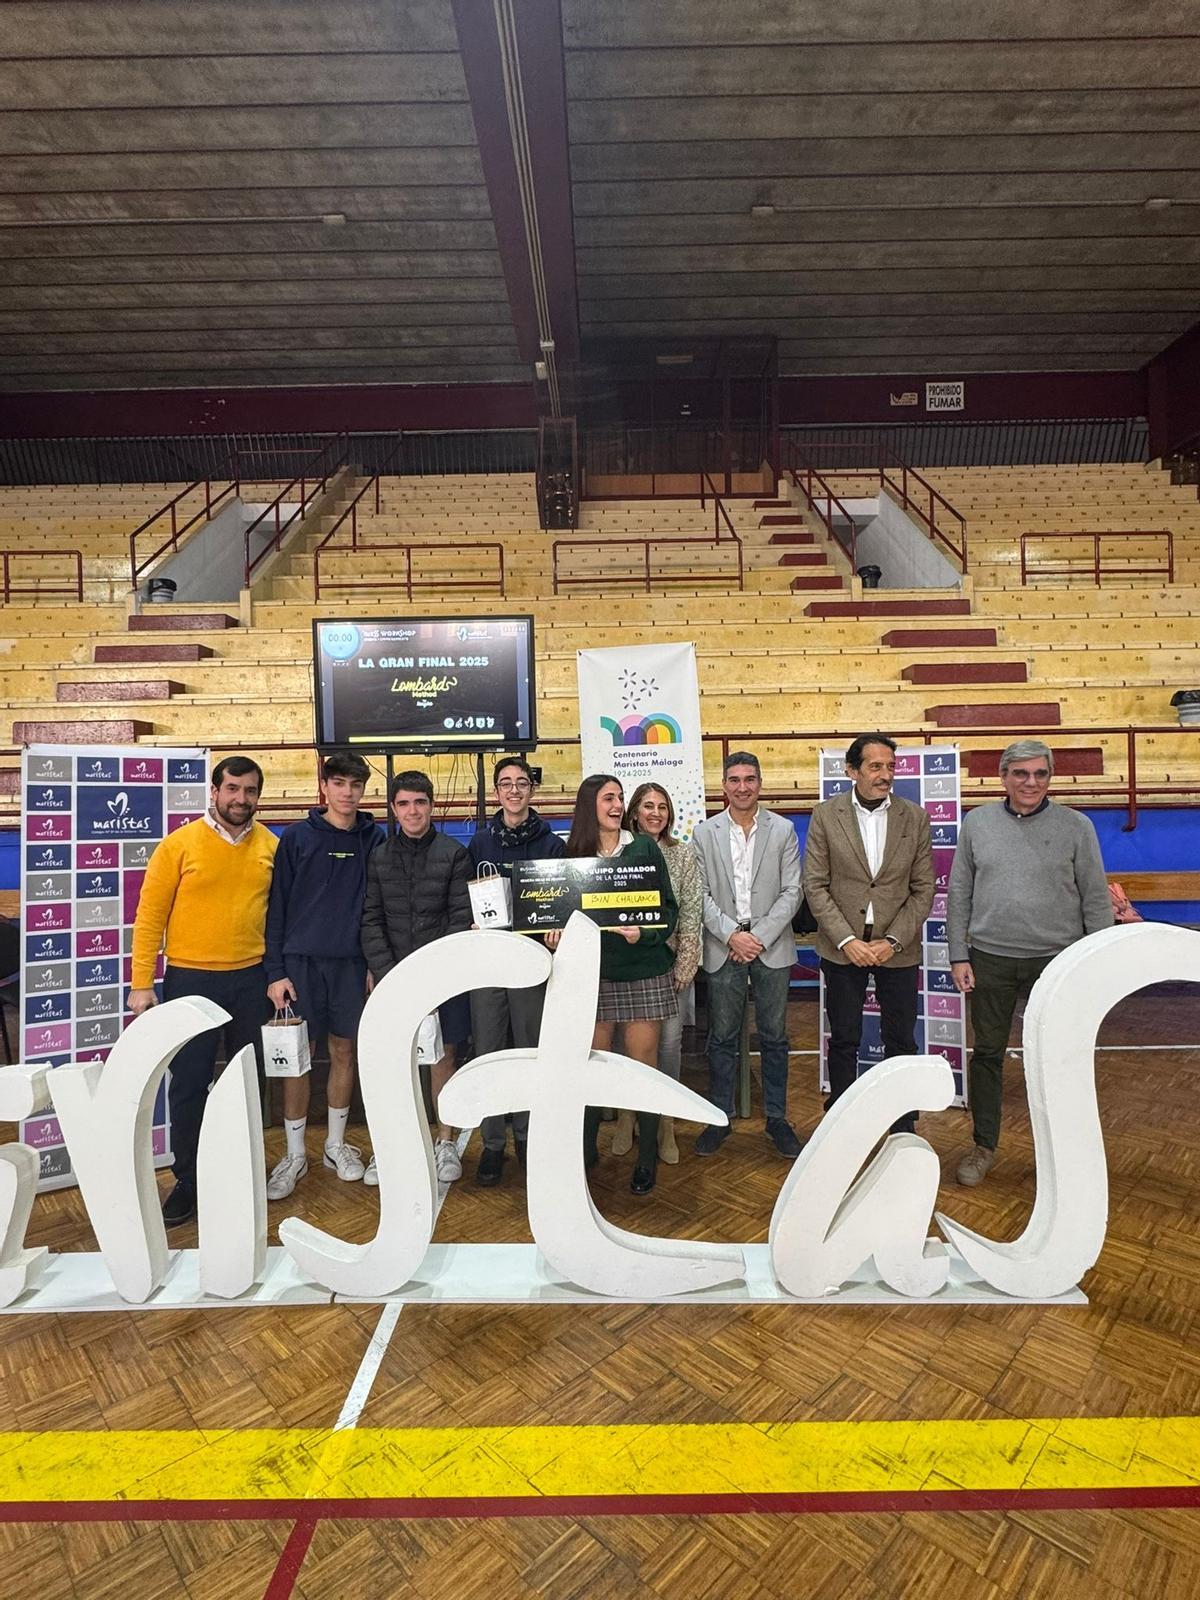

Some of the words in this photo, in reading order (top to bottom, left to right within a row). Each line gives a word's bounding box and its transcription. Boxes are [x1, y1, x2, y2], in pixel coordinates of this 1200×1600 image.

[929, 385, 961, 395] PROHIBIDO
[929, 397, 961, 408] FUMAR
[358, 658, 375, 668] LA
[379, 657, 414, 668] GRAN
[418, 656, 455, 668] FINAL
[459, 656, 489, 667] 2025
[613, 749, 658, 759] Centenario
[613, 760, 649, 768] Maristas
[651, 758, 684, 767] Málaga
[93, 816, 151, 830] maristas
[35, 859, 64, 867] maristas
[130, 856, 150, 864] marist
[617, 866, 656, 874] GANADOR
[35, 889, 63, 897] maristas
[35, 919, 63, 927] maristas
[35, 949, 63, 958] maristas
[85, 945, 112, 953] maristas
[85, 974, 112, 983] maristas
[35, 979, 64, 989] maristas
[85, 1003, 112, 1012] maristas
[35, 1009, 64, 1019] maristas
[84, 1033, 112, 1042] maristas
[34, 1039, 62, 1050] maristas
